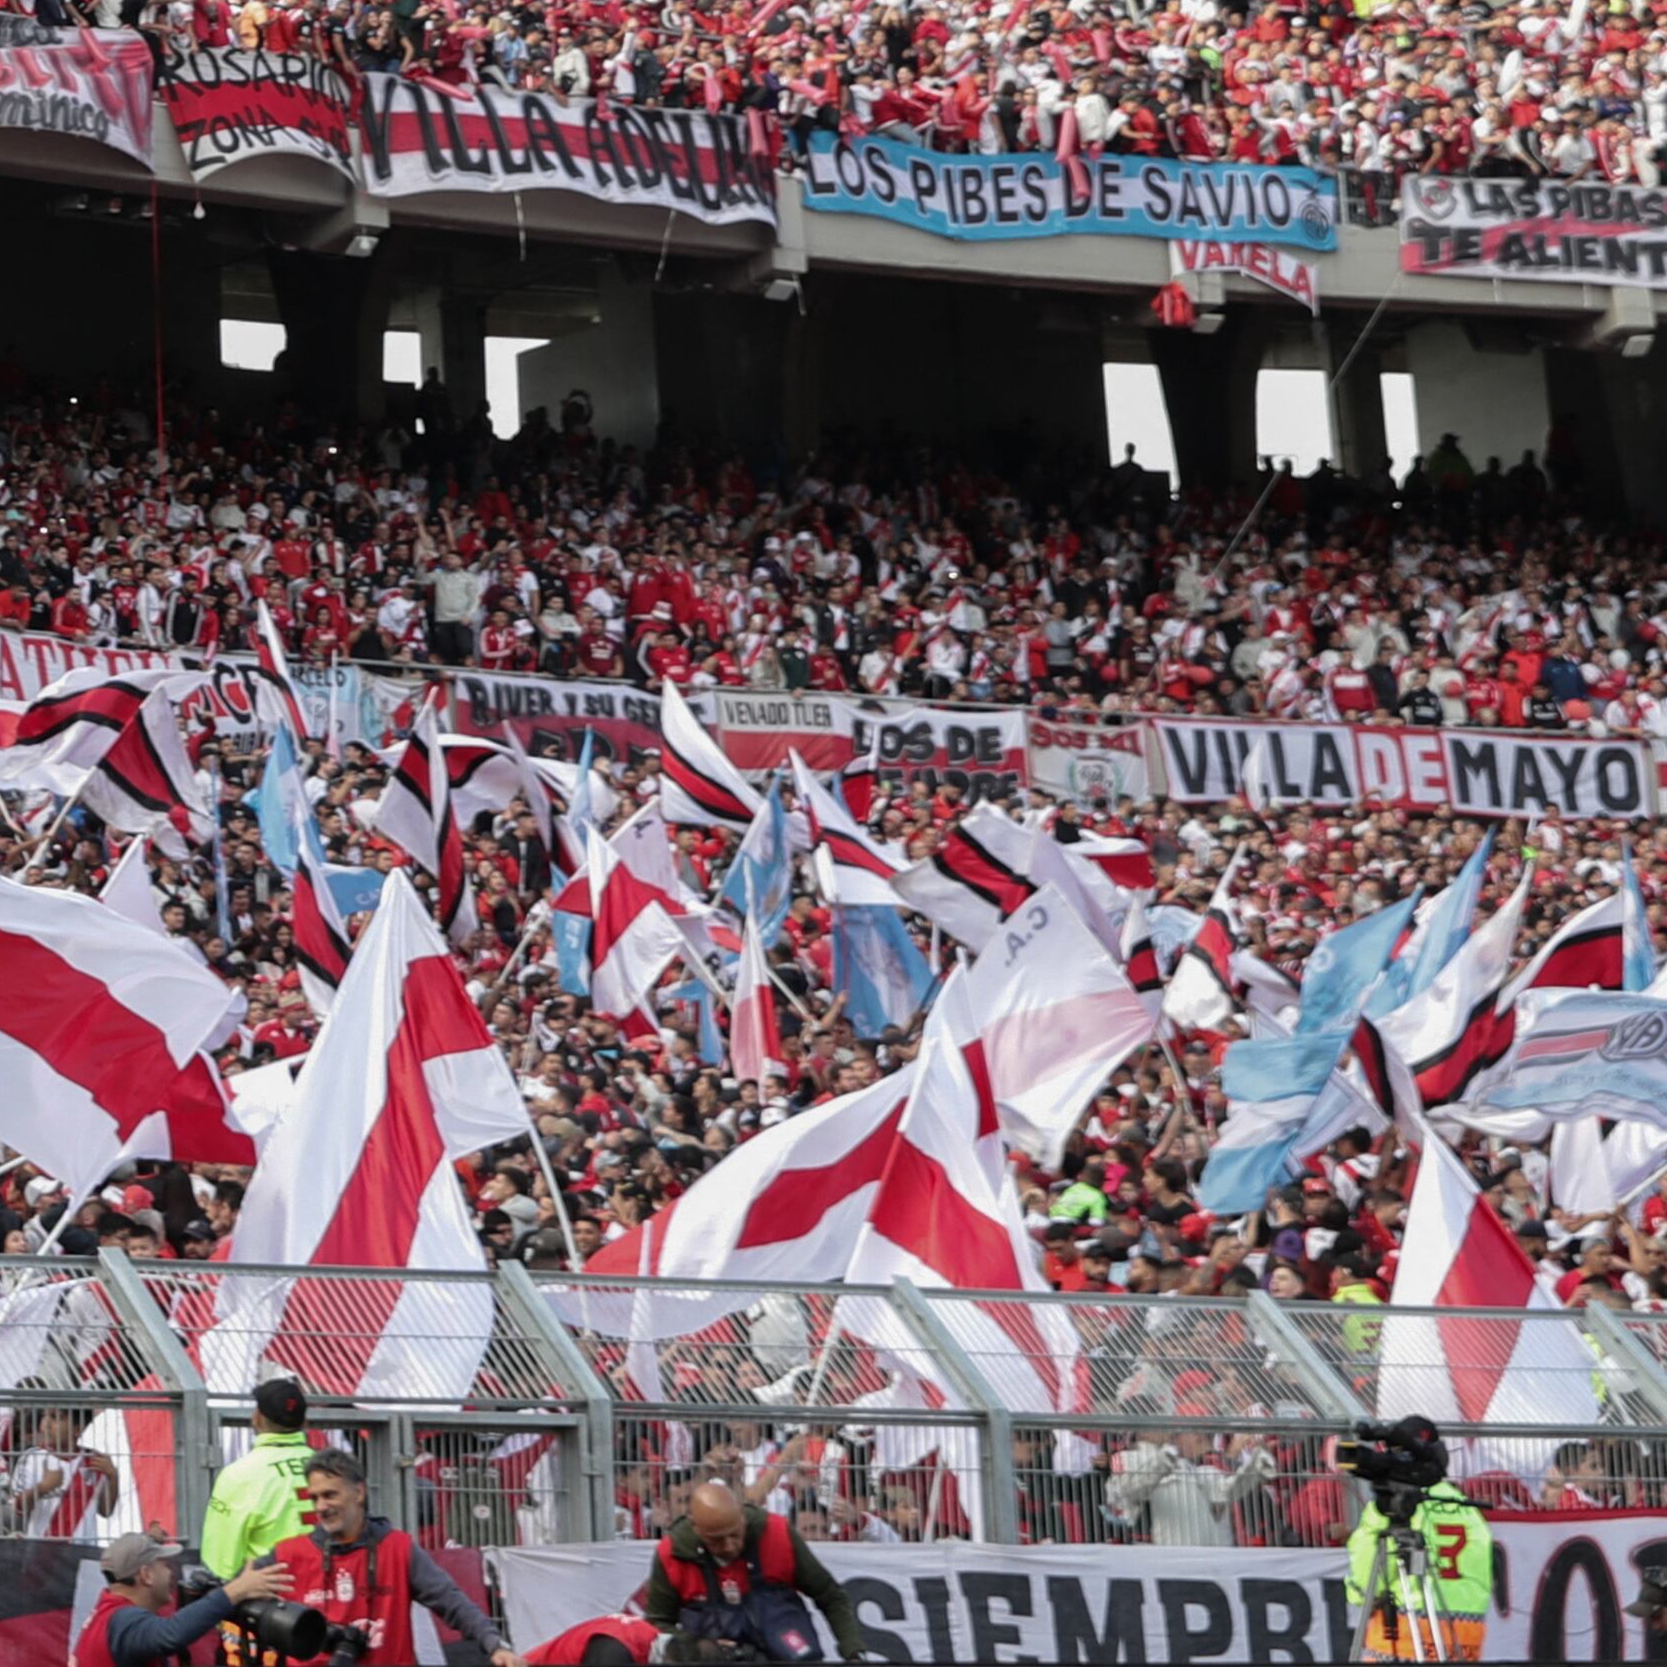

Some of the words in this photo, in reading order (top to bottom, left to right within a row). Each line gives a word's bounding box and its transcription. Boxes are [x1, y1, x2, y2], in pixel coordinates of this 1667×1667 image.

[365, 73, 584, 179] VILLA
[805, 141, 896, 203] LOS
[909, 158, 1051, 225] PIBES
[1064, 160, 1121, 220] DE
[1142, 163, 1292, 230] SAVIO
[1463, 180, 1540, 219] LAS
[1548, 184, 1667, 229] PIBAS
[1407, 218, 1483, 262] TE
[466, 676, 554, 727] RIVER
[583, 692, 616, 718] SU
[725, 700, 789, 727] VENADO
[852, 718, 936, 763] LOS
[945, 724, 1004, 764] DE
[1170, 724, 1353, 800] VILLA
[1362, 731, 1446, 802] DE
[1452, 739, 1641, 814] MAYO
[1435, 1524, 1468, 1580] 3
